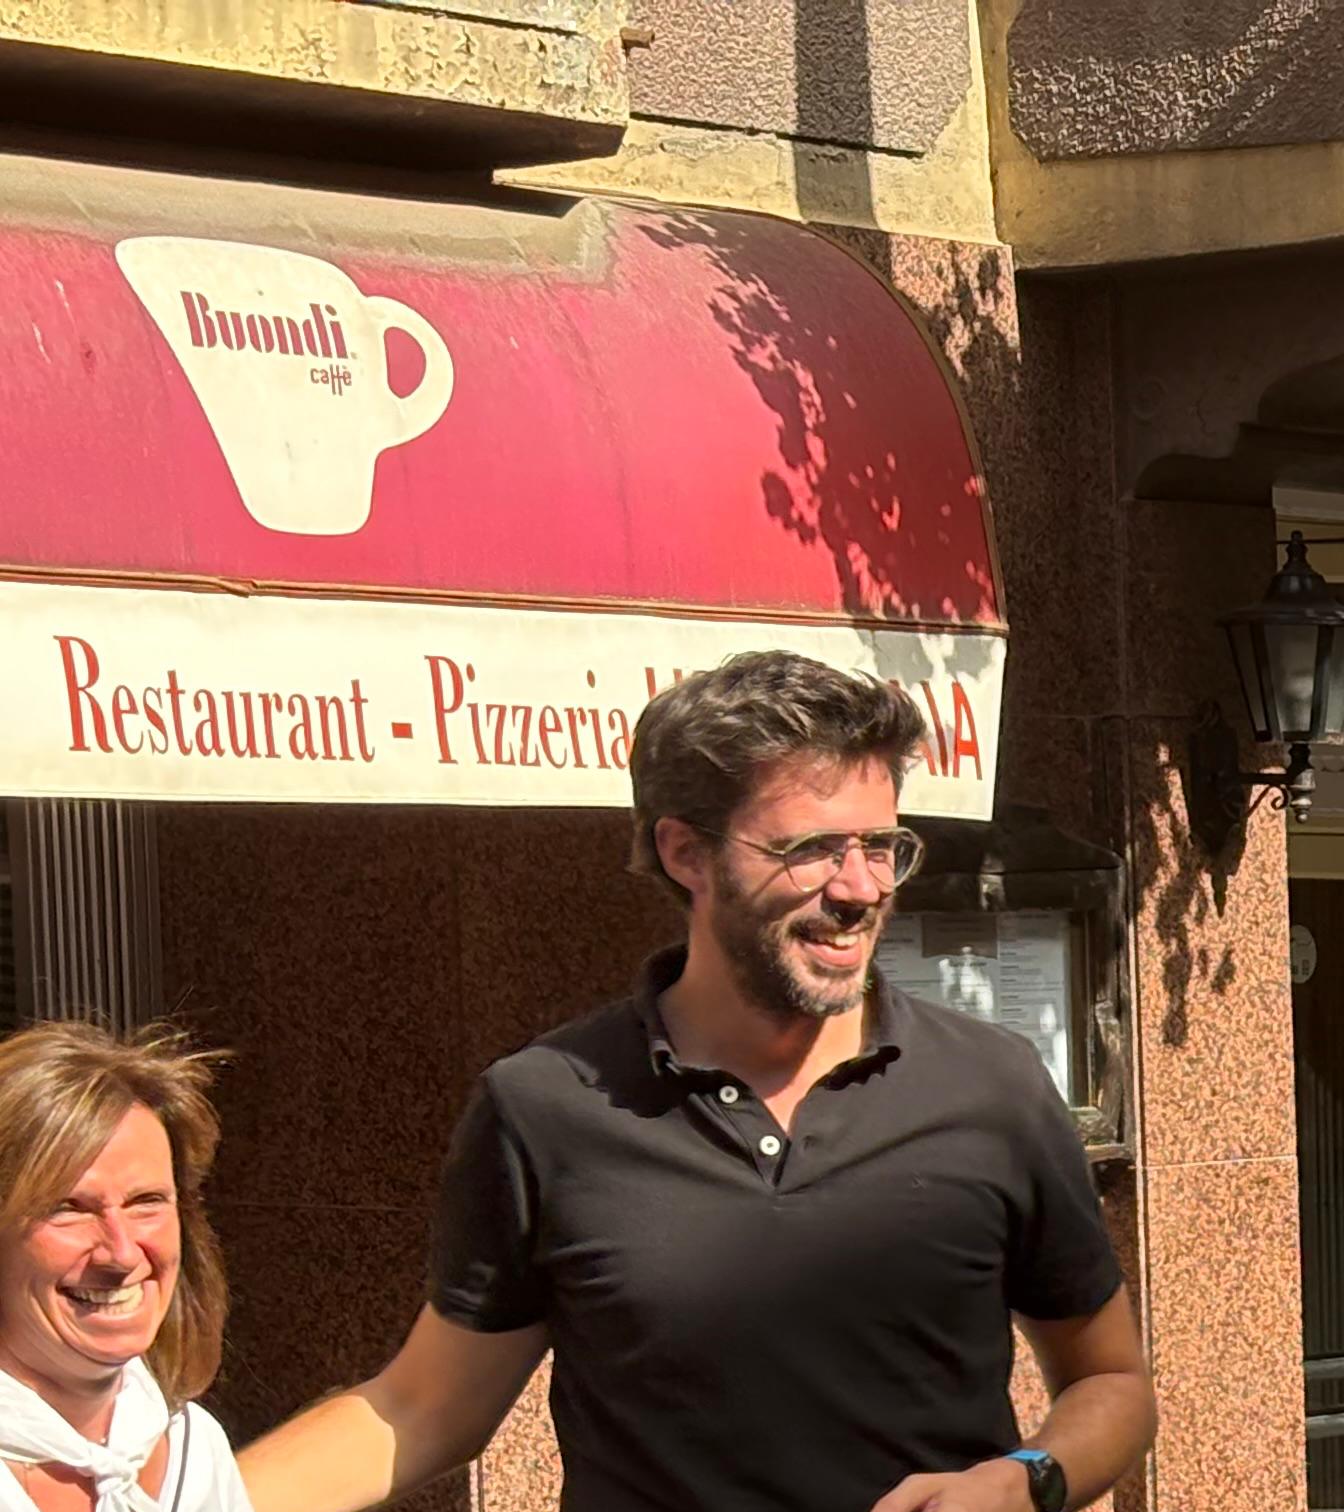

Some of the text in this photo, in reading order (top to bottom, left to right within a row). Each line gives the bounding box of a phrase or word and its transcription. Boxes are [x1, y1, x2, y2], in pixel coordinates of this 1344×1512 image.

[180, 290, 348, 359] Buondi
[53, 634, 376, 763] Restaurant
[424, 654, 633, 770] Pizzeria
